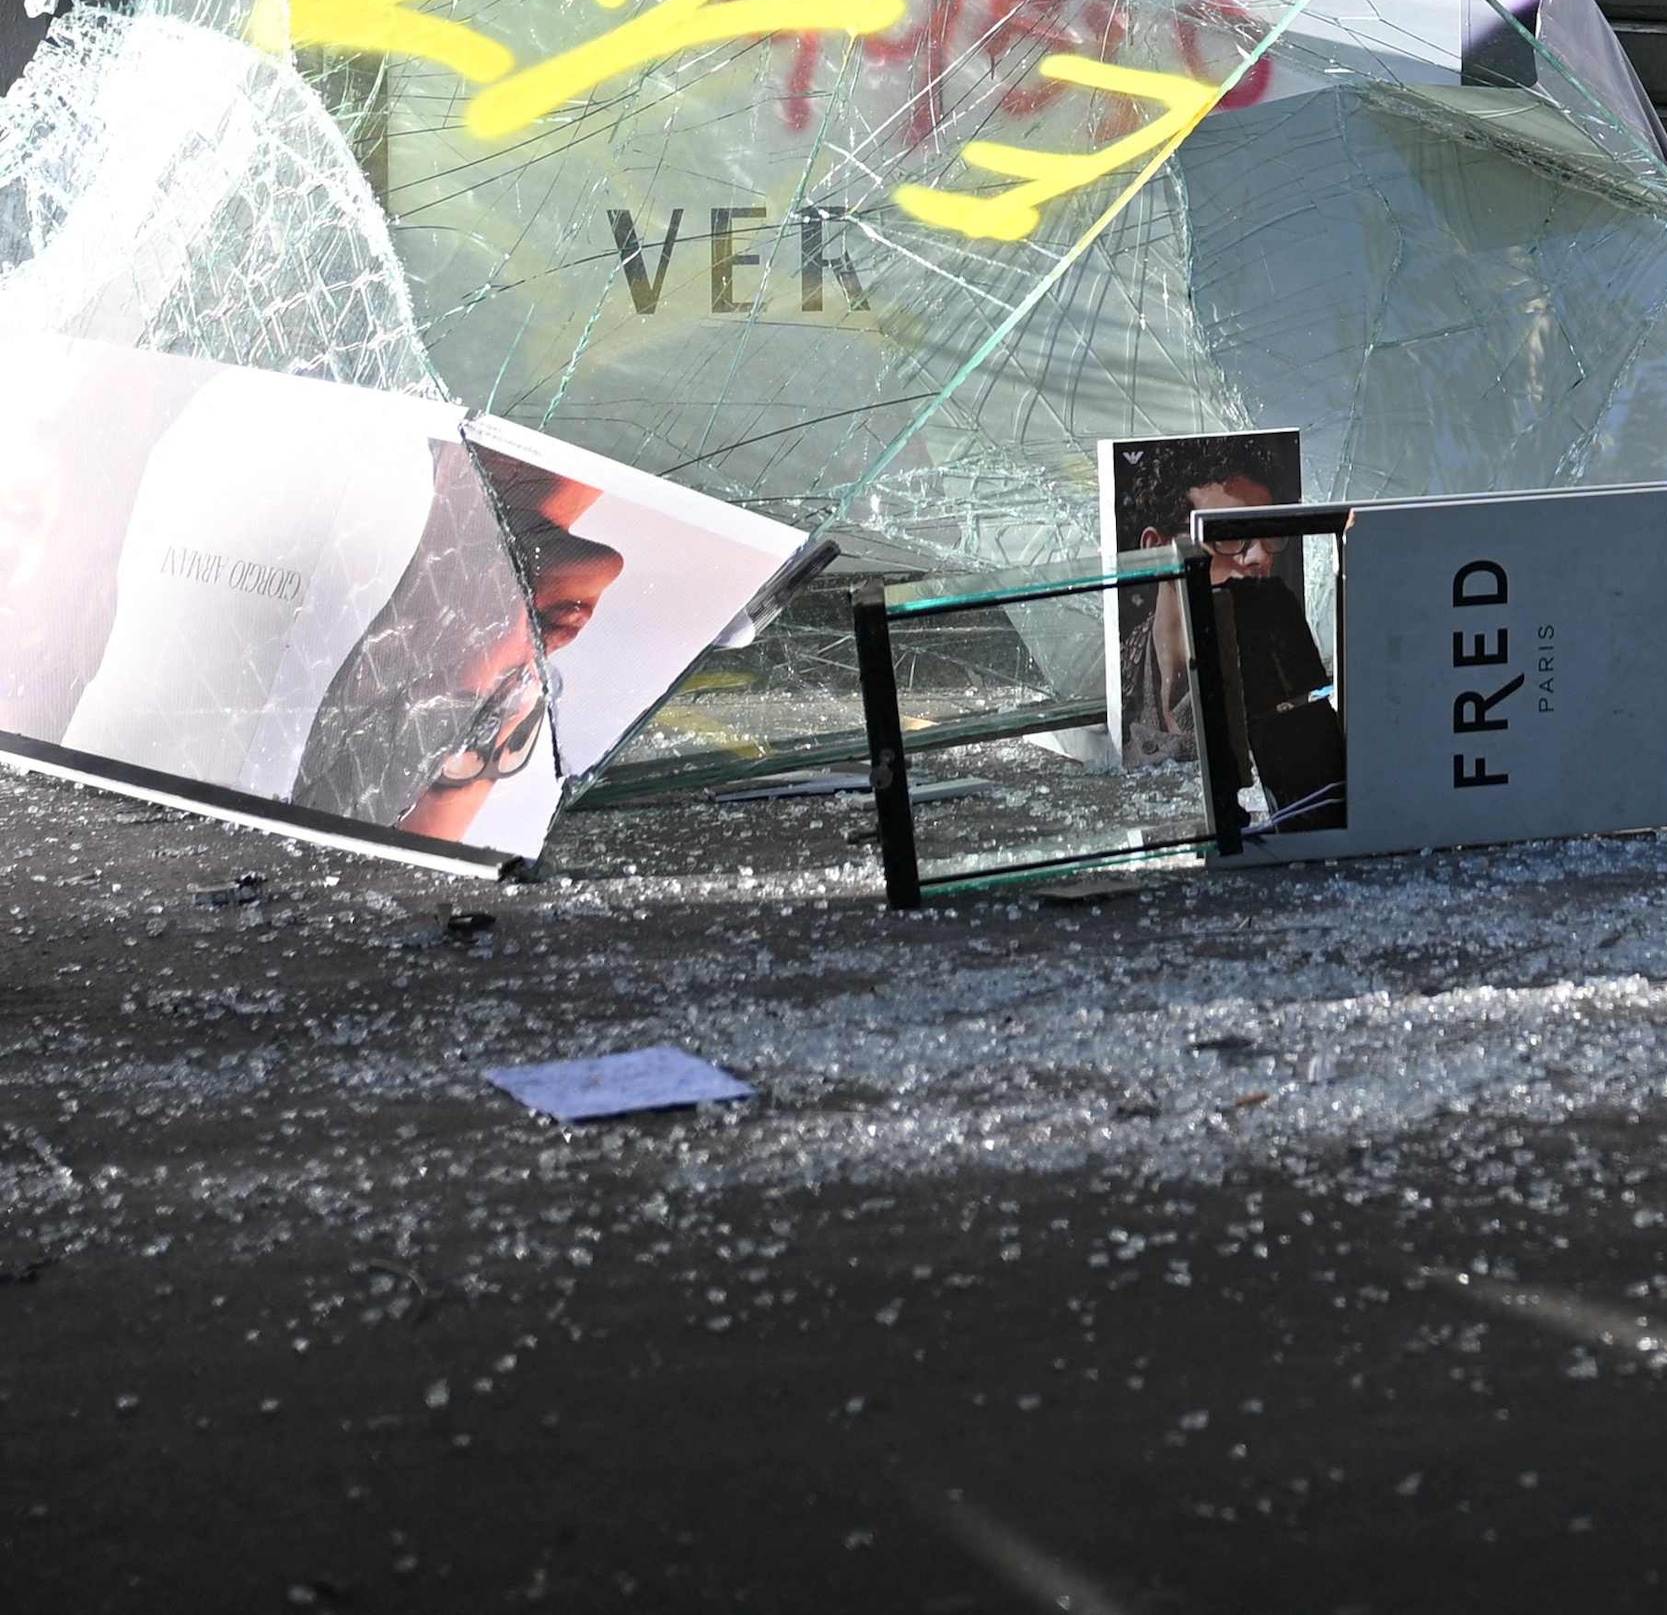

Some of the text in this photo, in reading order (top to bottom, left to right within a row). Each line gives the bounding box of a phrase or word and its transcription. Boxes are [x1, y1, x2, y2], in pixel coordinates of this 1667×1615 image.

[229, 560, 301, 601] GIORGIO
[1452, 559, 1525, 789] FRED
[1538, 624, 1555, 713] PARIS
